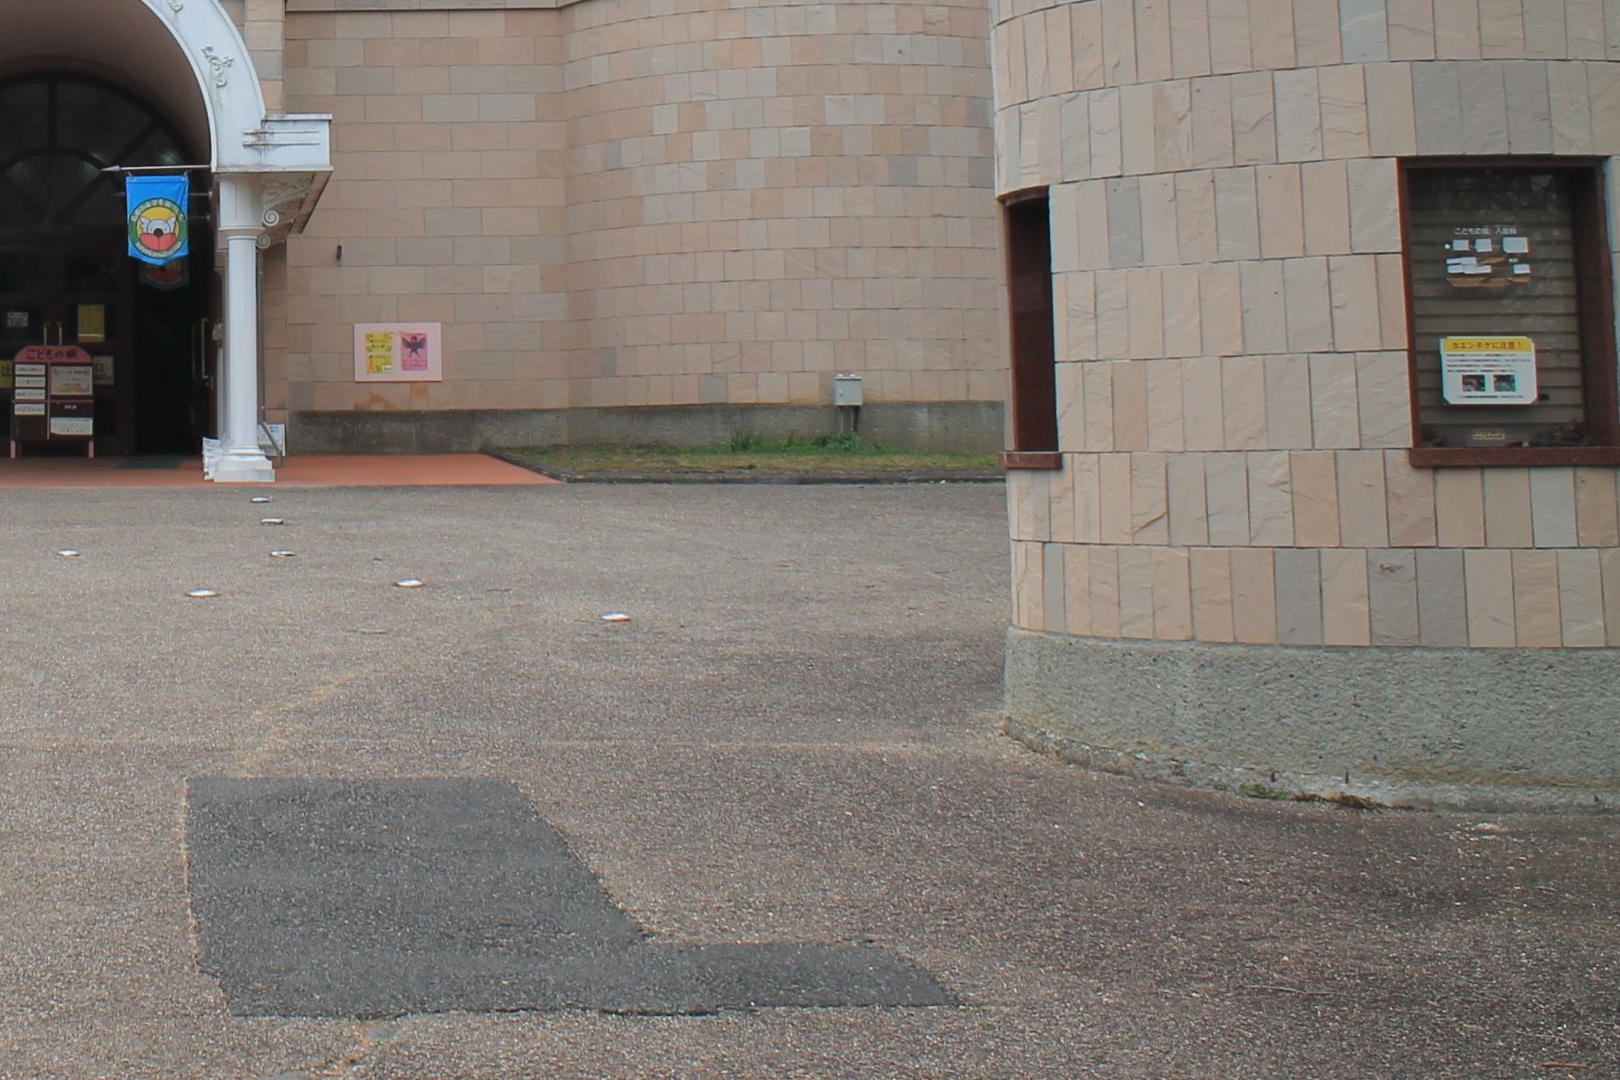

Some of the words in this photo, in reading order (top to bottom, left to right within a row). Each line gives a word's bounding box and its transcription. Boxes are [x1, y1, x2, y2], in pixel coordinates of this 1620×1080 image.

[26, 349, 79, 361] こどもの城
